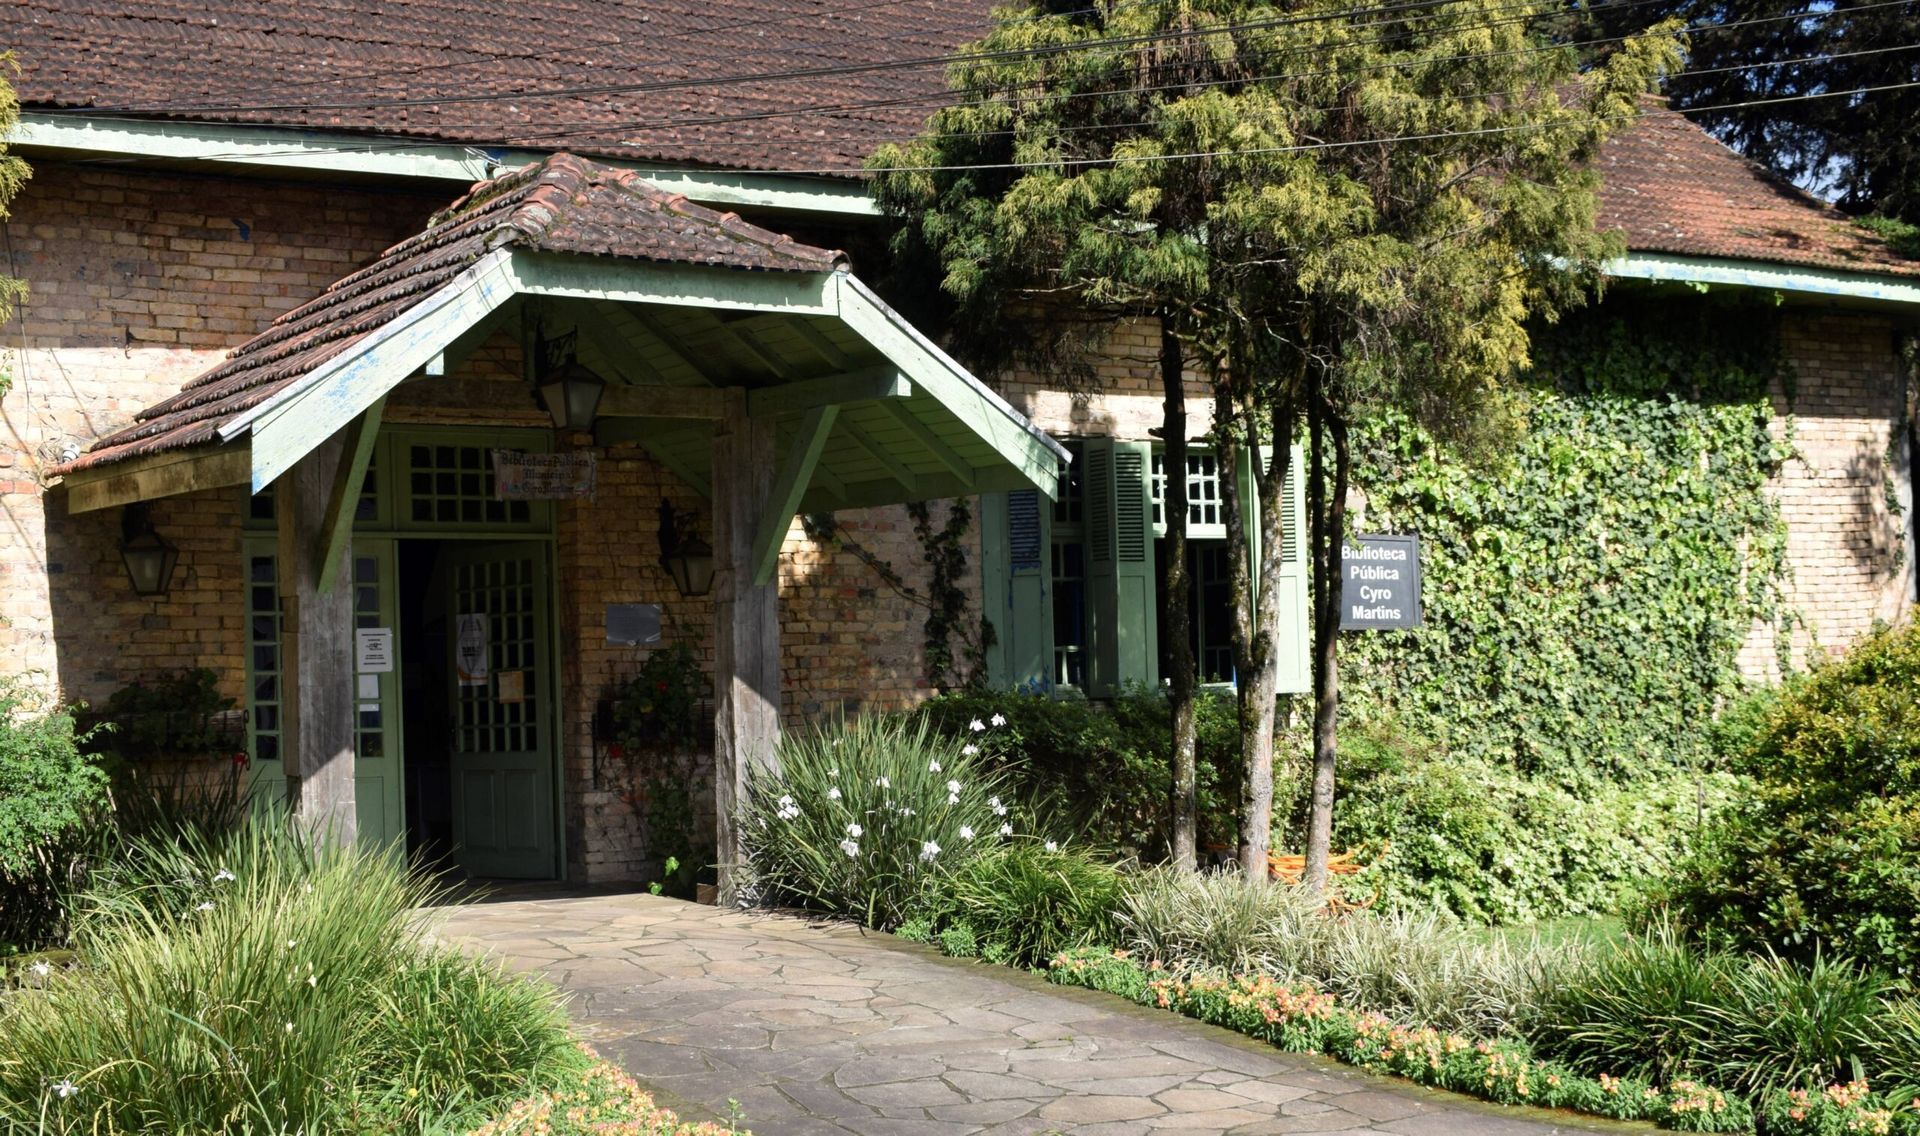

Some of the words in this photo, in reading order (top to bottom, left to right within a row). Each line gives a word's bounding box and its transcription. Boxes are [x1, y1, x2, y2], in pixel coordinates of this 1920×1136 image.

[1341, 545, 1406, 560] Biblioteca
[1350, 565, 1399, 580] Pública
[1360, 585, 1392, 603] Cyro
[1352, 605, 1401, 620] Martins
